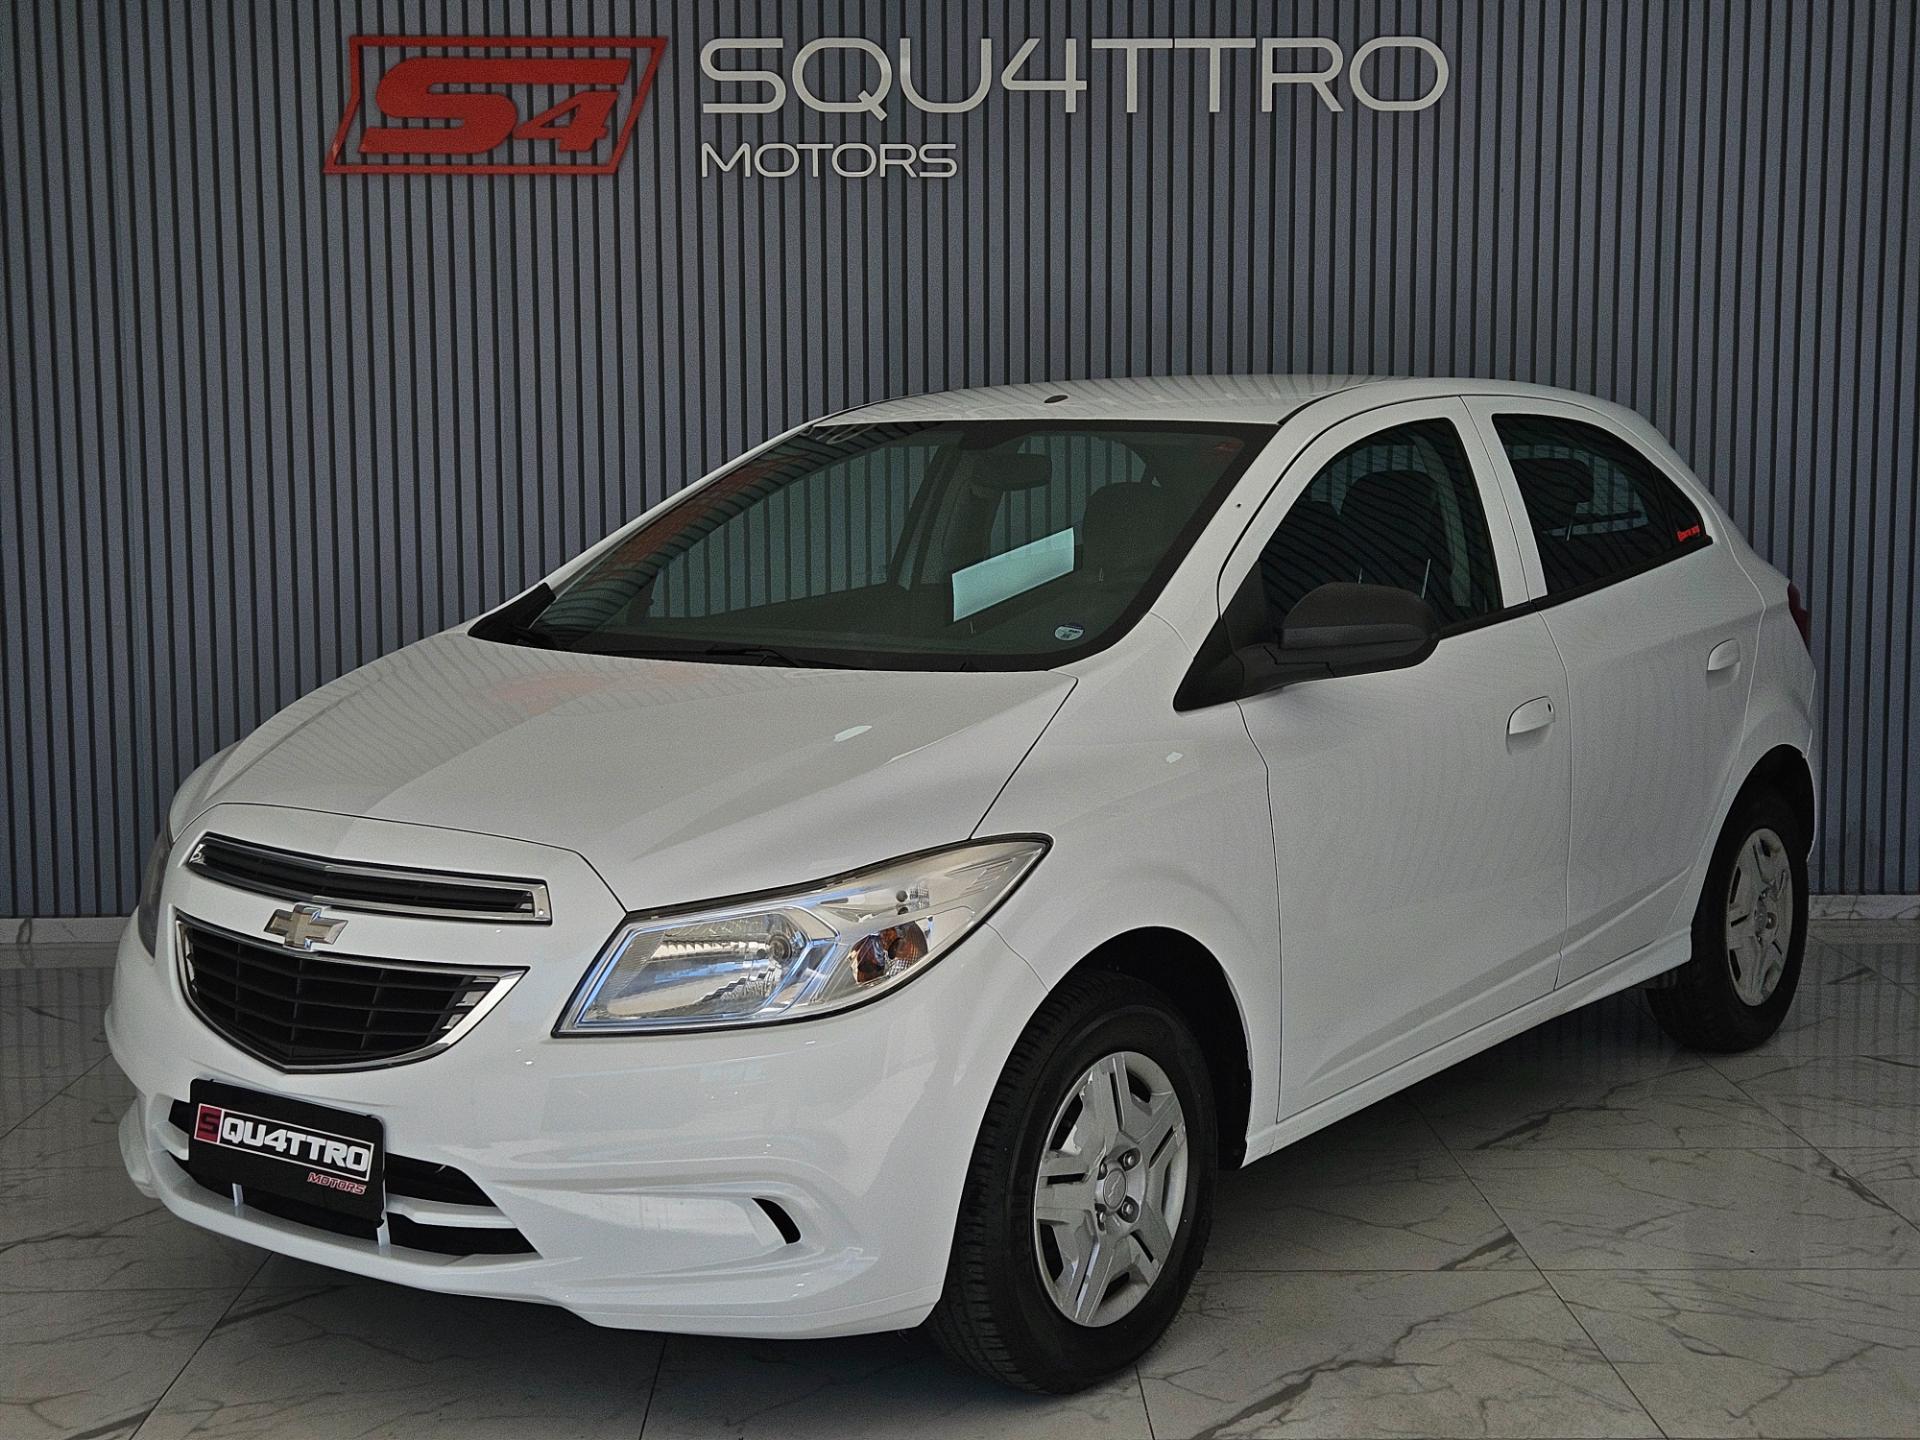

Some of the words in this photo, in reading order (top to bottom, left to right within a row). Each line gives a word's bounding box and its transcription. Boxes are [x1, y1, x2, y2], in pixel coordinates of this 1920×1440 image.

[357, 57, 631, 155] S4
[700, 36, 1450, 122] SQU4TTRO
[701, 143, 957, 178] MOTORS
[197, 1107, 370, 1172] SQU4TTRO
[307, 1172, 367, 1195] MOTORS
